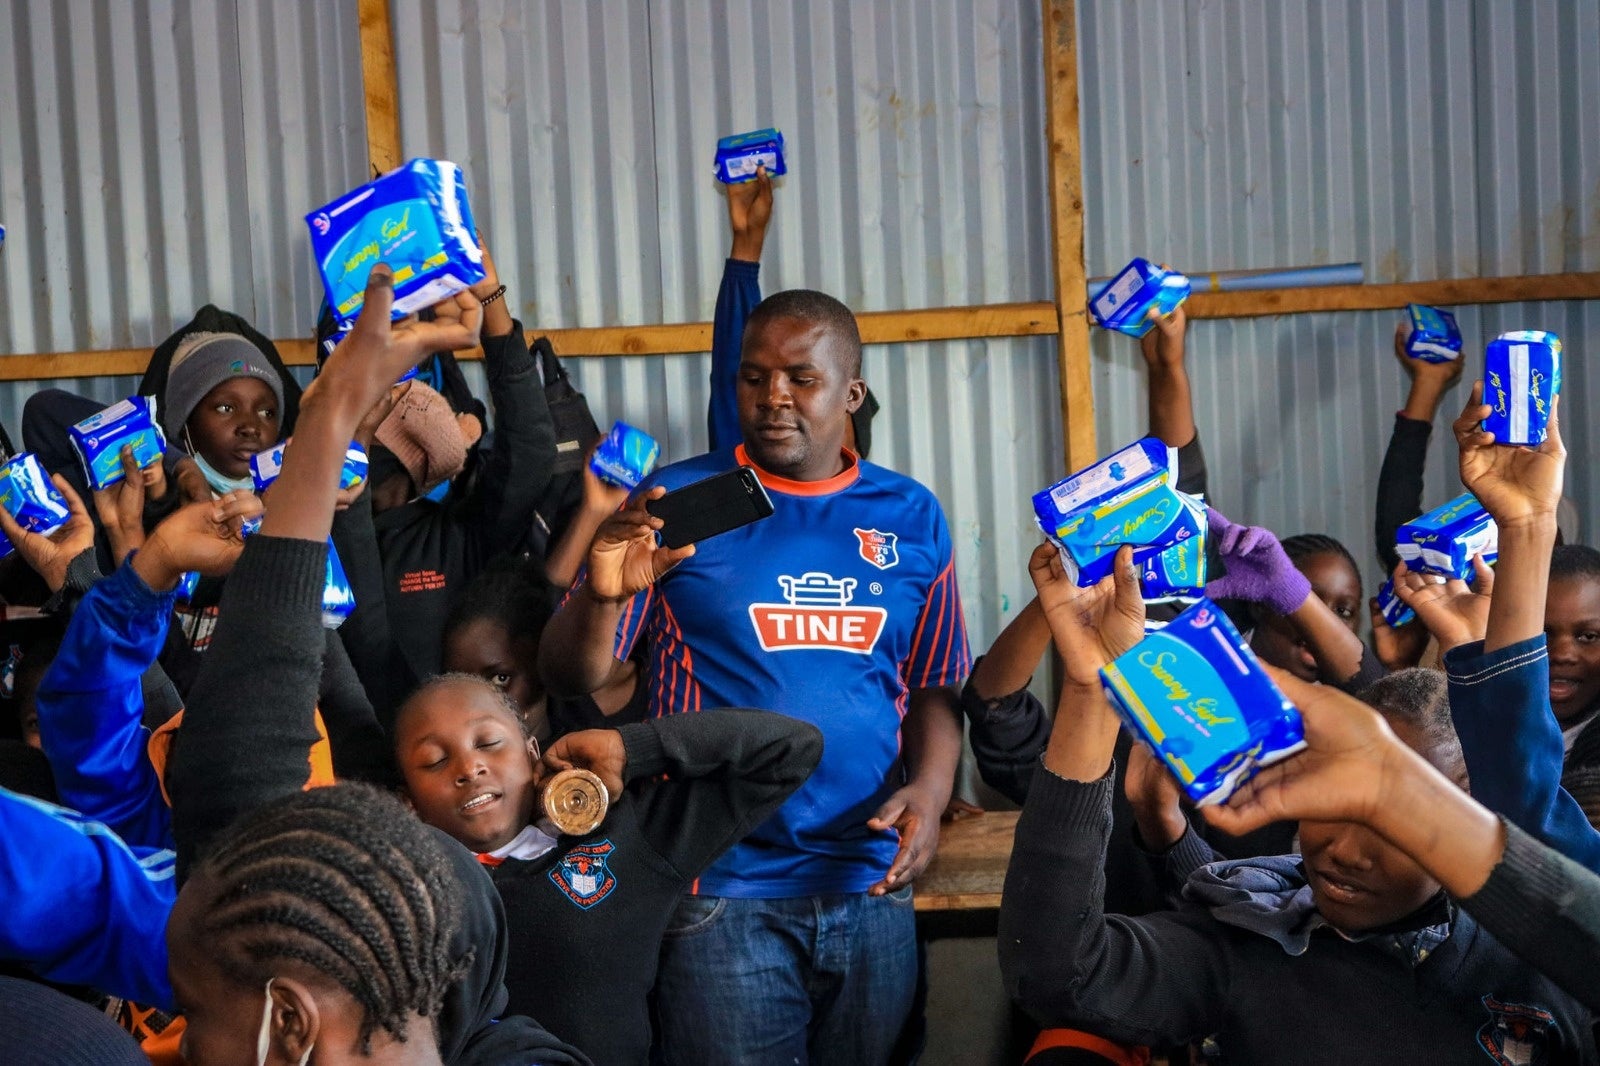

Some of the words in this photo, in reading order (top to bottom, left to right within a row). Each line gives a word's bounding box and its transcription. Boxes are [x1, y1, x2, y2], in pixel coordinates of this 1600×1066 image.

[767, 613, 867, 643] TINE
[1138, 650, 1192, 700] Sunny
[1188, 697, 1236, 727] Girl
